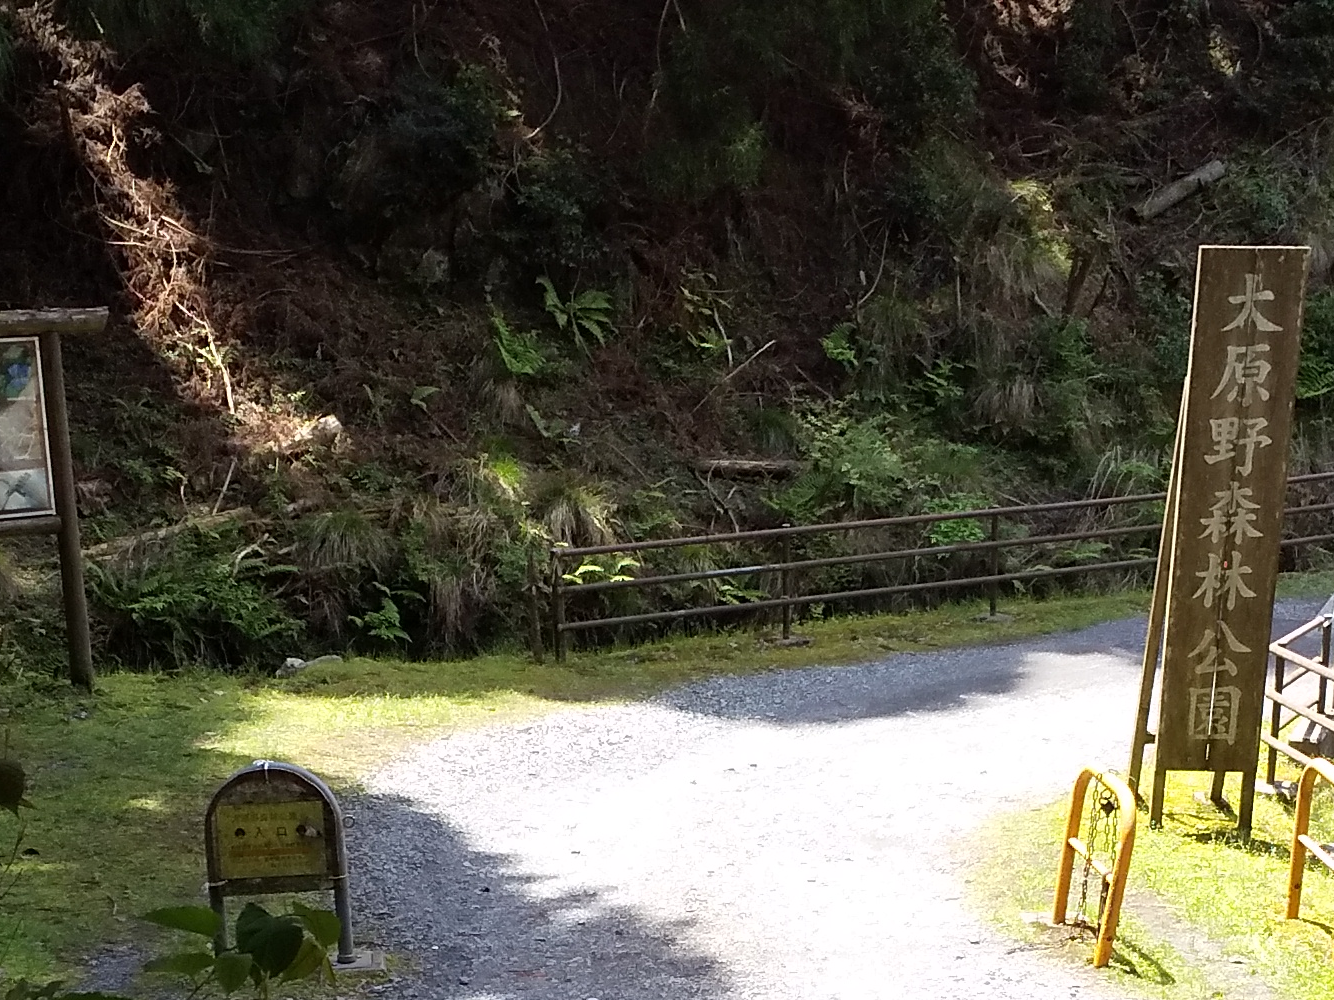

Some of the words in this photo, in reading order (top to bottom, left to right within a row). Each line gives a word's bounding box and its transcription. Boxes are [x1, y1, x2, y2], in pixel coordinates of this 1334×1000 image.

[1187, 273, 1283, 744] 大原野森林公園
